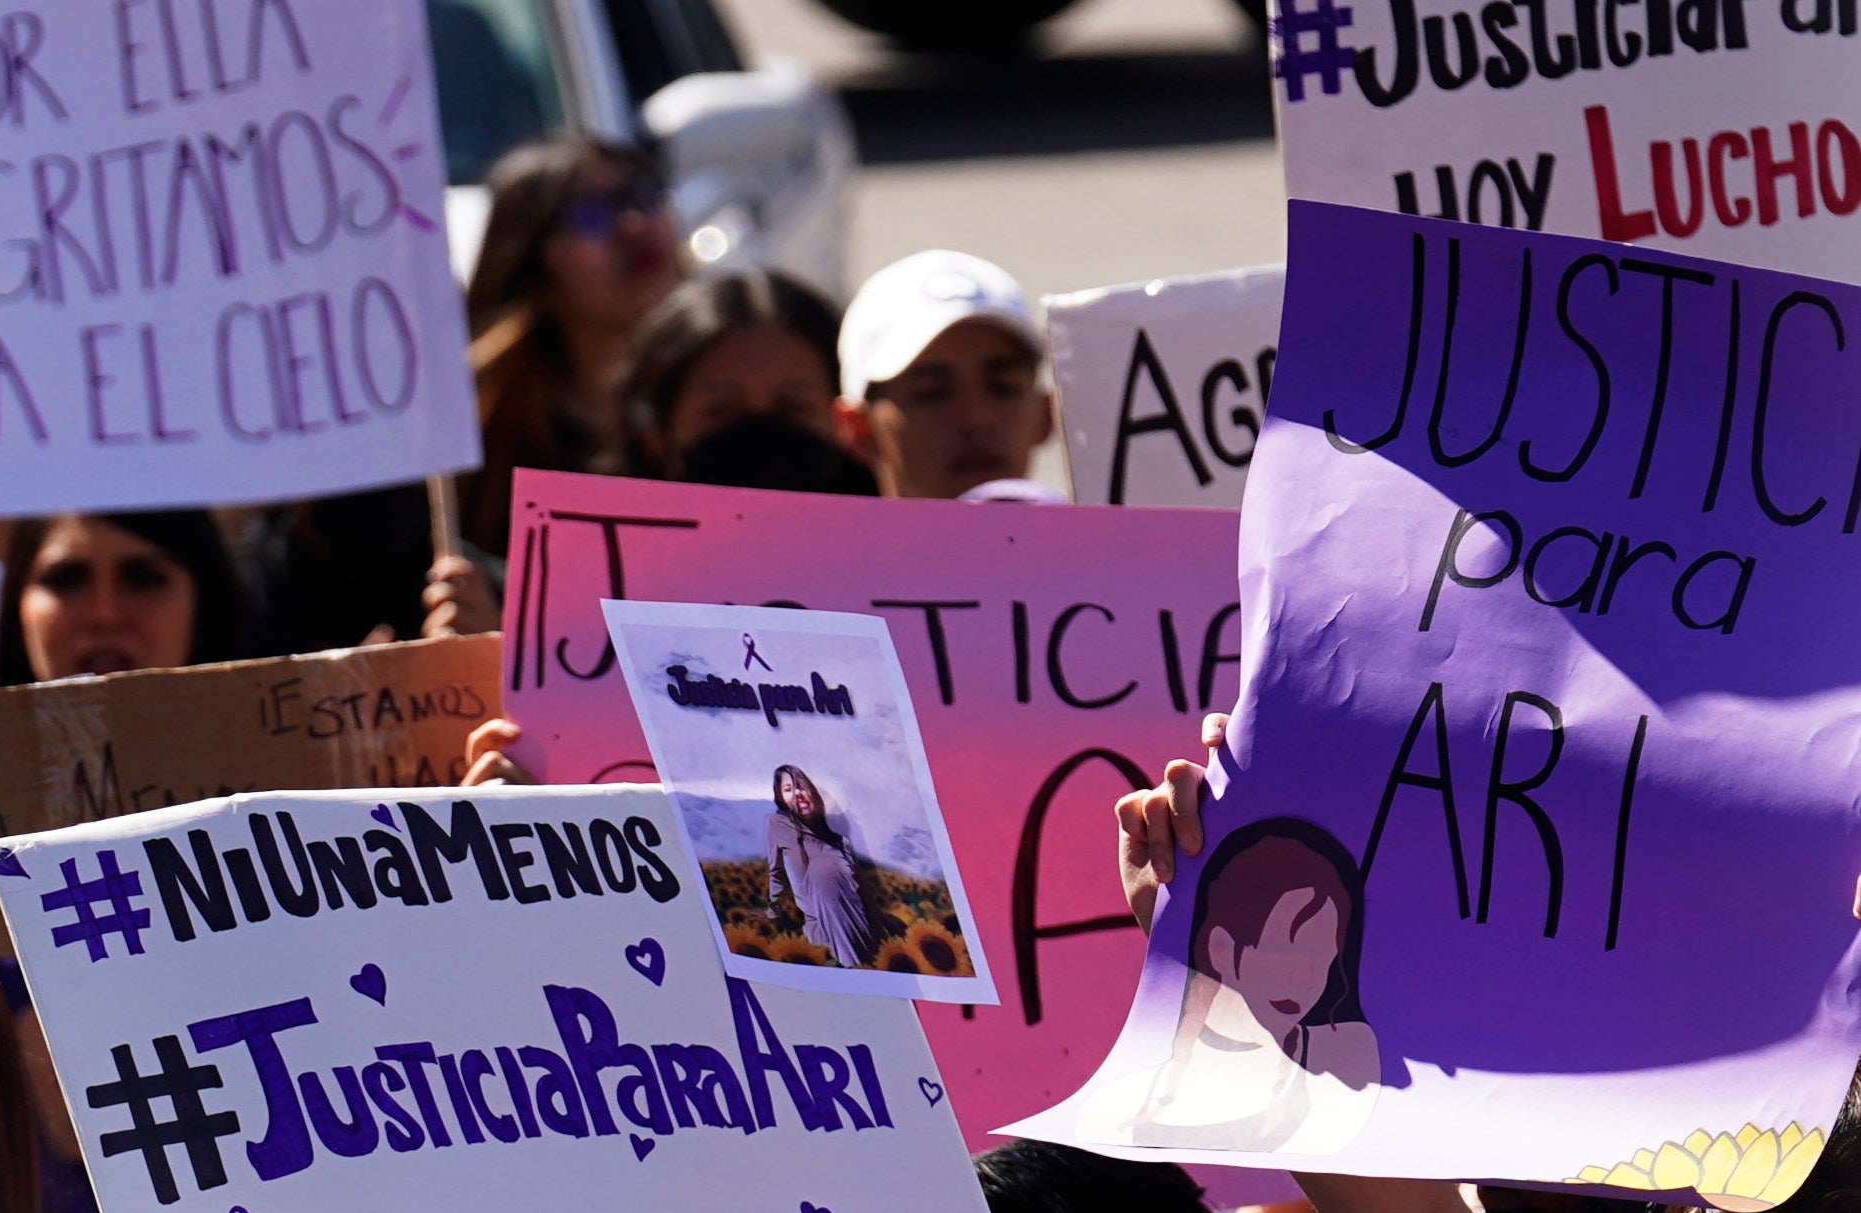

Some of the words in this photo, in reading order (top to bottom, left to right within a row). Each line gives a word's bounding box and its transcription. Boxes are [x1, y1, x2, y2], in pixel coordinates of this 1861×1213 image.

[117, 0, 312, 114] ELLA
[1583, 104, 1861, 242] LUCHO
[82, 322, 199, 444] EL
[217, 276, 418, 443] CIELO
[1418, 508, 1757, 634] para
[1359, 682, 1650, 952] ARI
